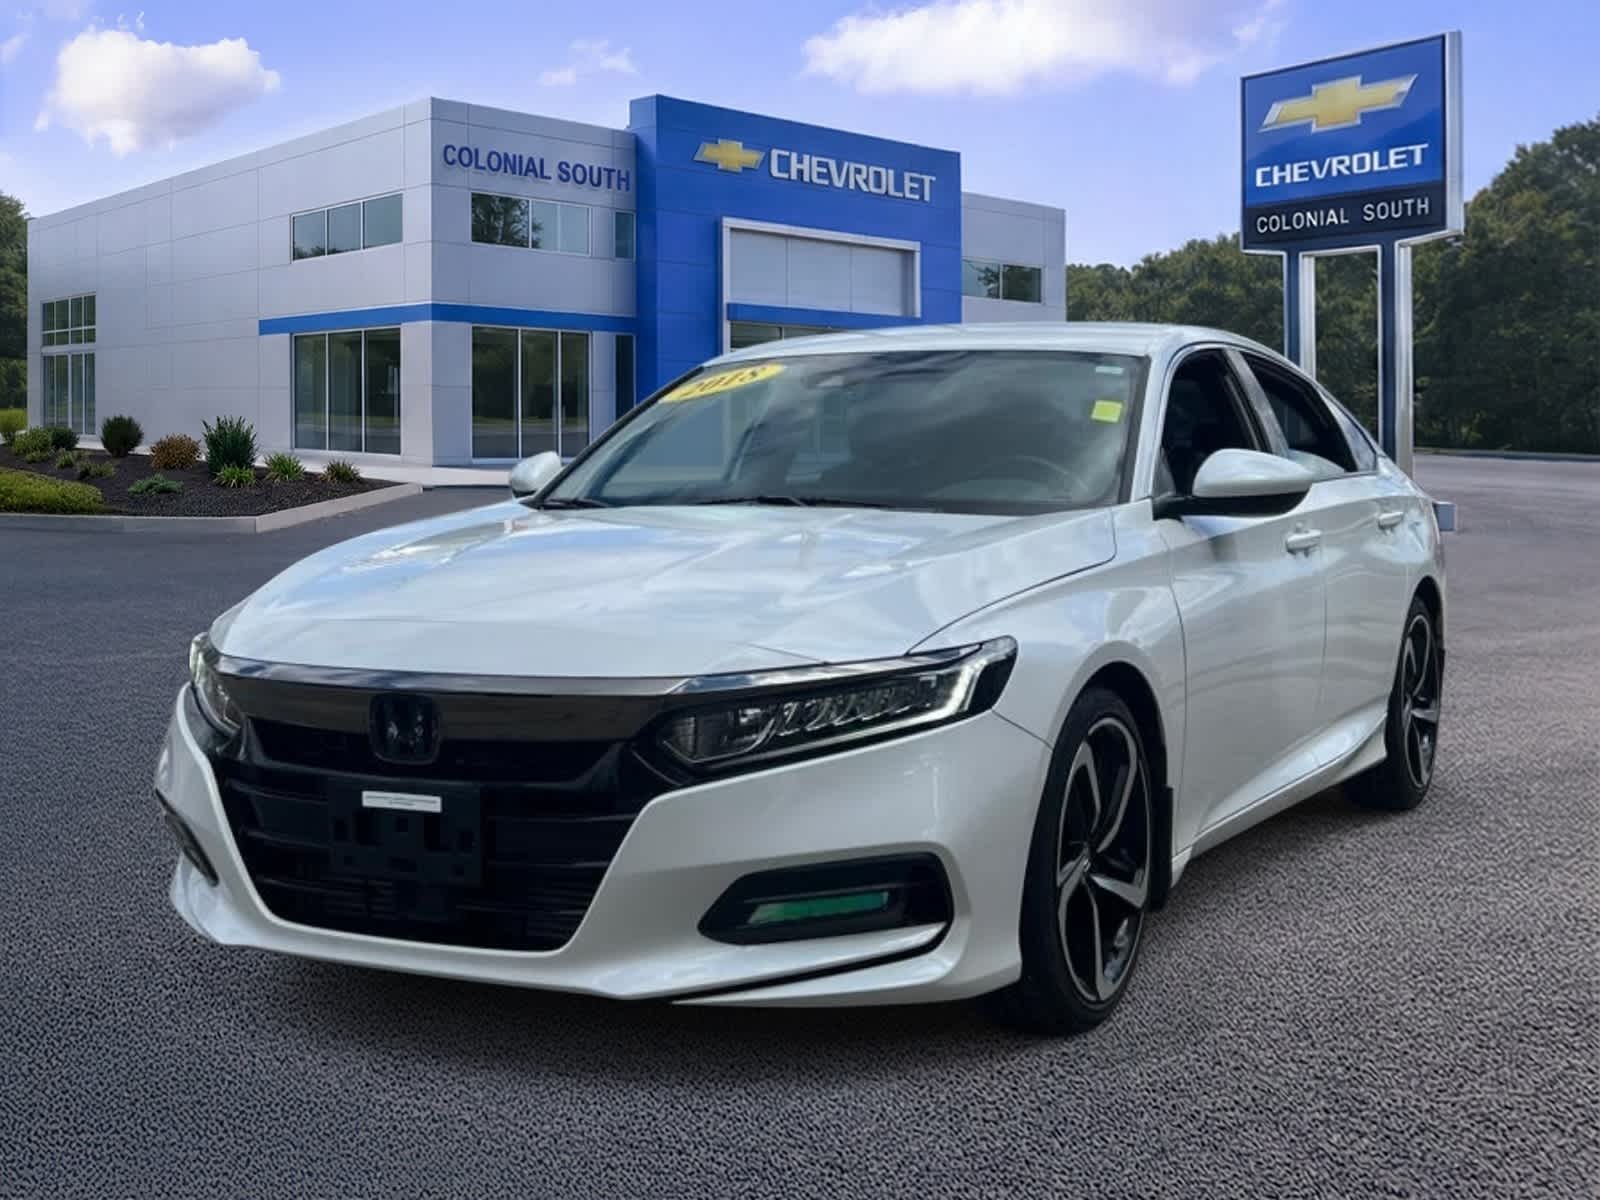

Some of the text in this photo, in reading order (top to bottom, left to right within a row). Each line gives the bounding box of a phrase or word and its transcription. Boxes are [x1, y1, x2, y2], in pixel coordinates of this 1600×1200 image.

[443, 144, 631, 192] COLONIAL SOUTH
[769, 148, 937, 202] CHEVROLET
[1255, 143, 1429, 187] CHEVROLET
[1256, 197, 1430, 234] COLONIAL SOUTH
